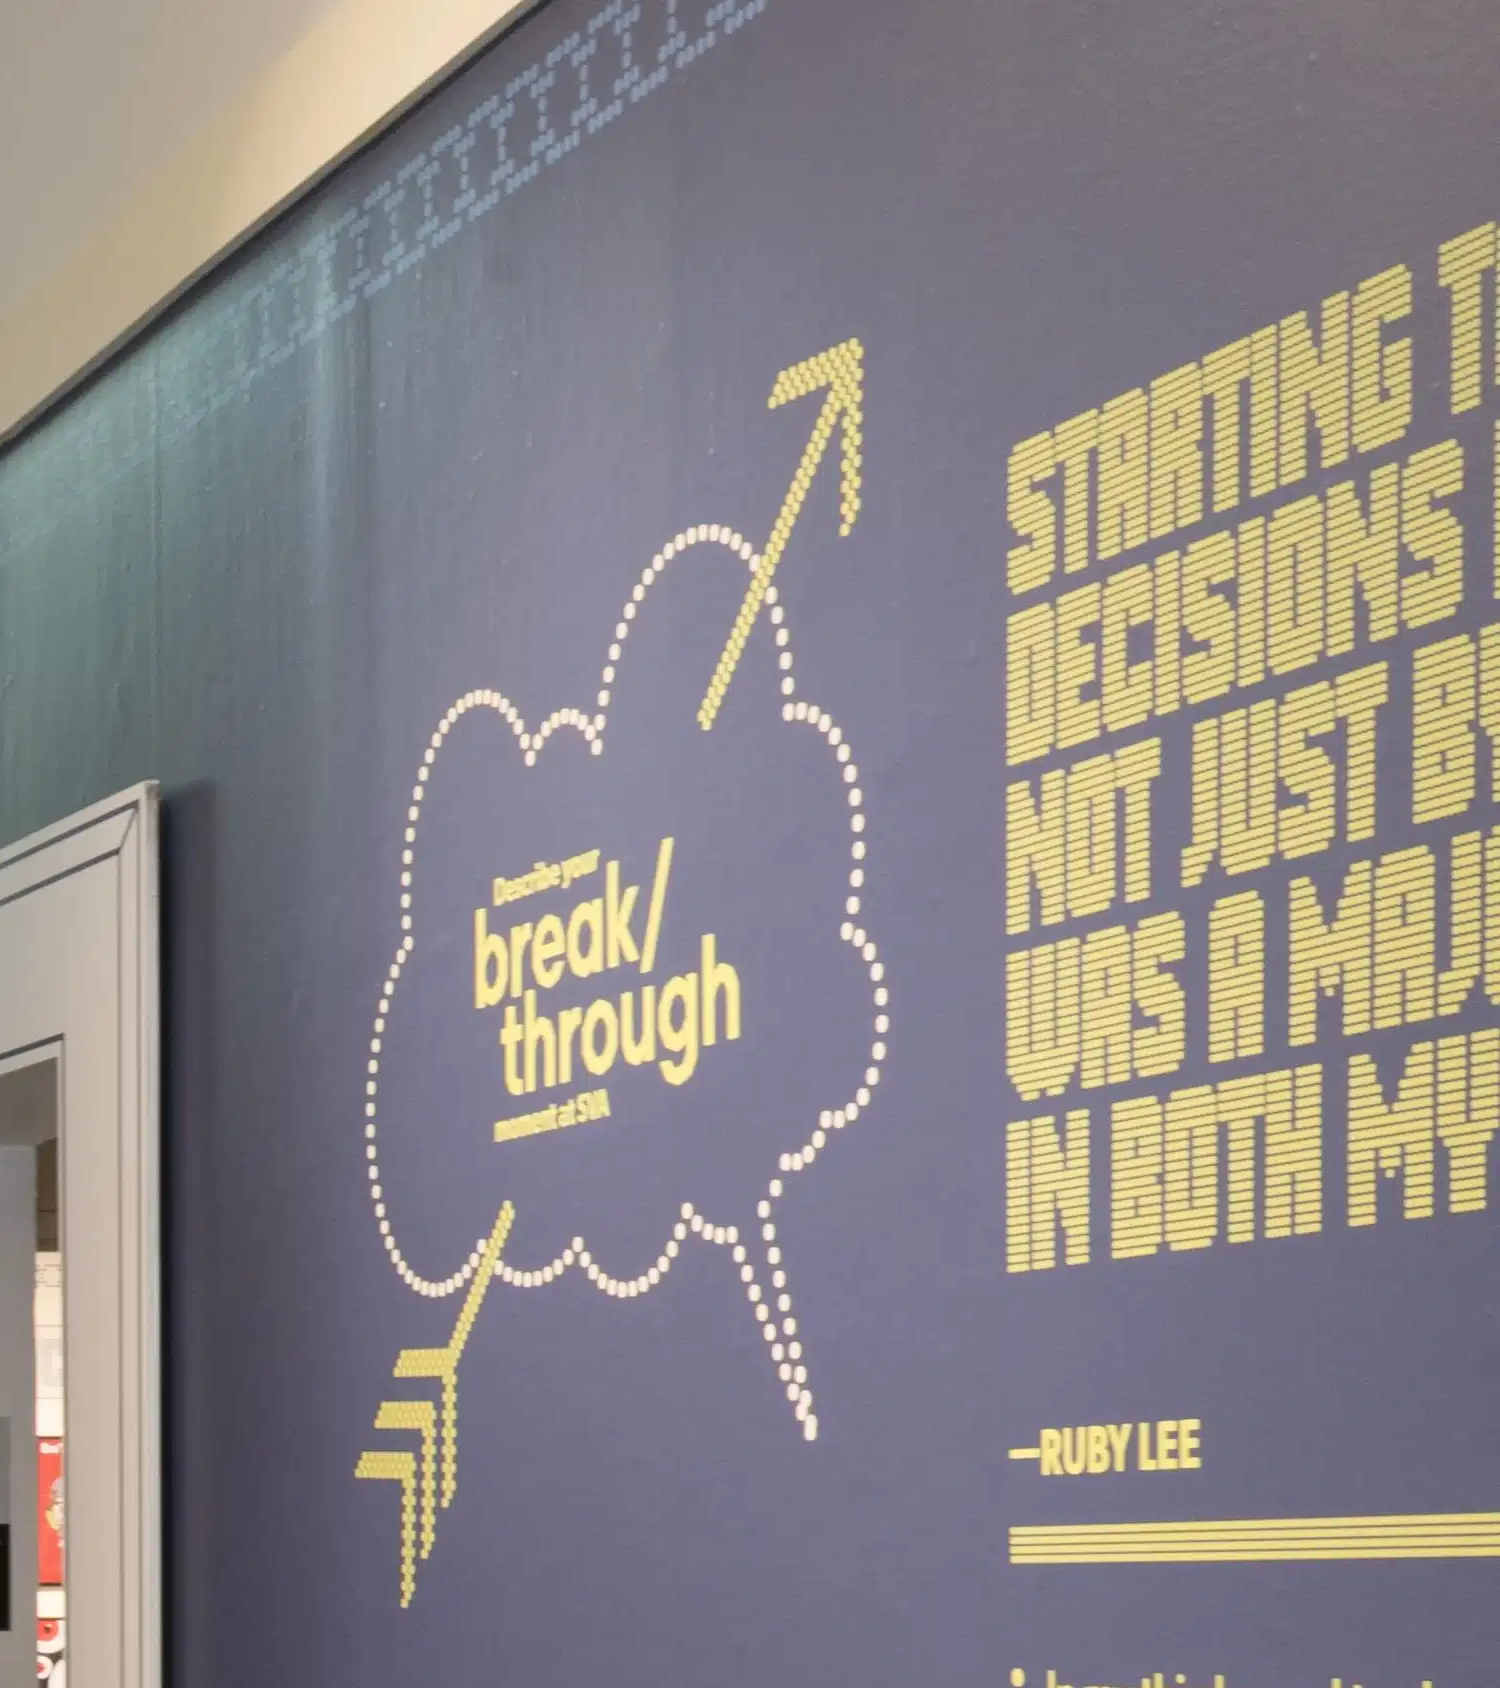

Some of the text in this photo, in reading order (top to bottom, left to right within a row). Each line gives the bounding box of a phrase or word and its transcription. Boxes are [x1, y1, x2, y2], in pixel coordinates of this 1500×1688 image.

[1007, 263, 1412, 595] STARTING
[1438, 221, 1500, 416] T
[1006, 438, 1464, 766] DECISIONS
[474, 837, 673, 1009] break/
[1006, 737, 1161, 934] NOT
[1181, 661, 1388, 888] JUST
[500, 933, 741, 1096] through
[1006, 824, 1500, 1101] WAS A MAJ
[1007, 1028, 1500, 1273] IN BOTH MY
[1138, 1418, 1201, 1470] LEE
